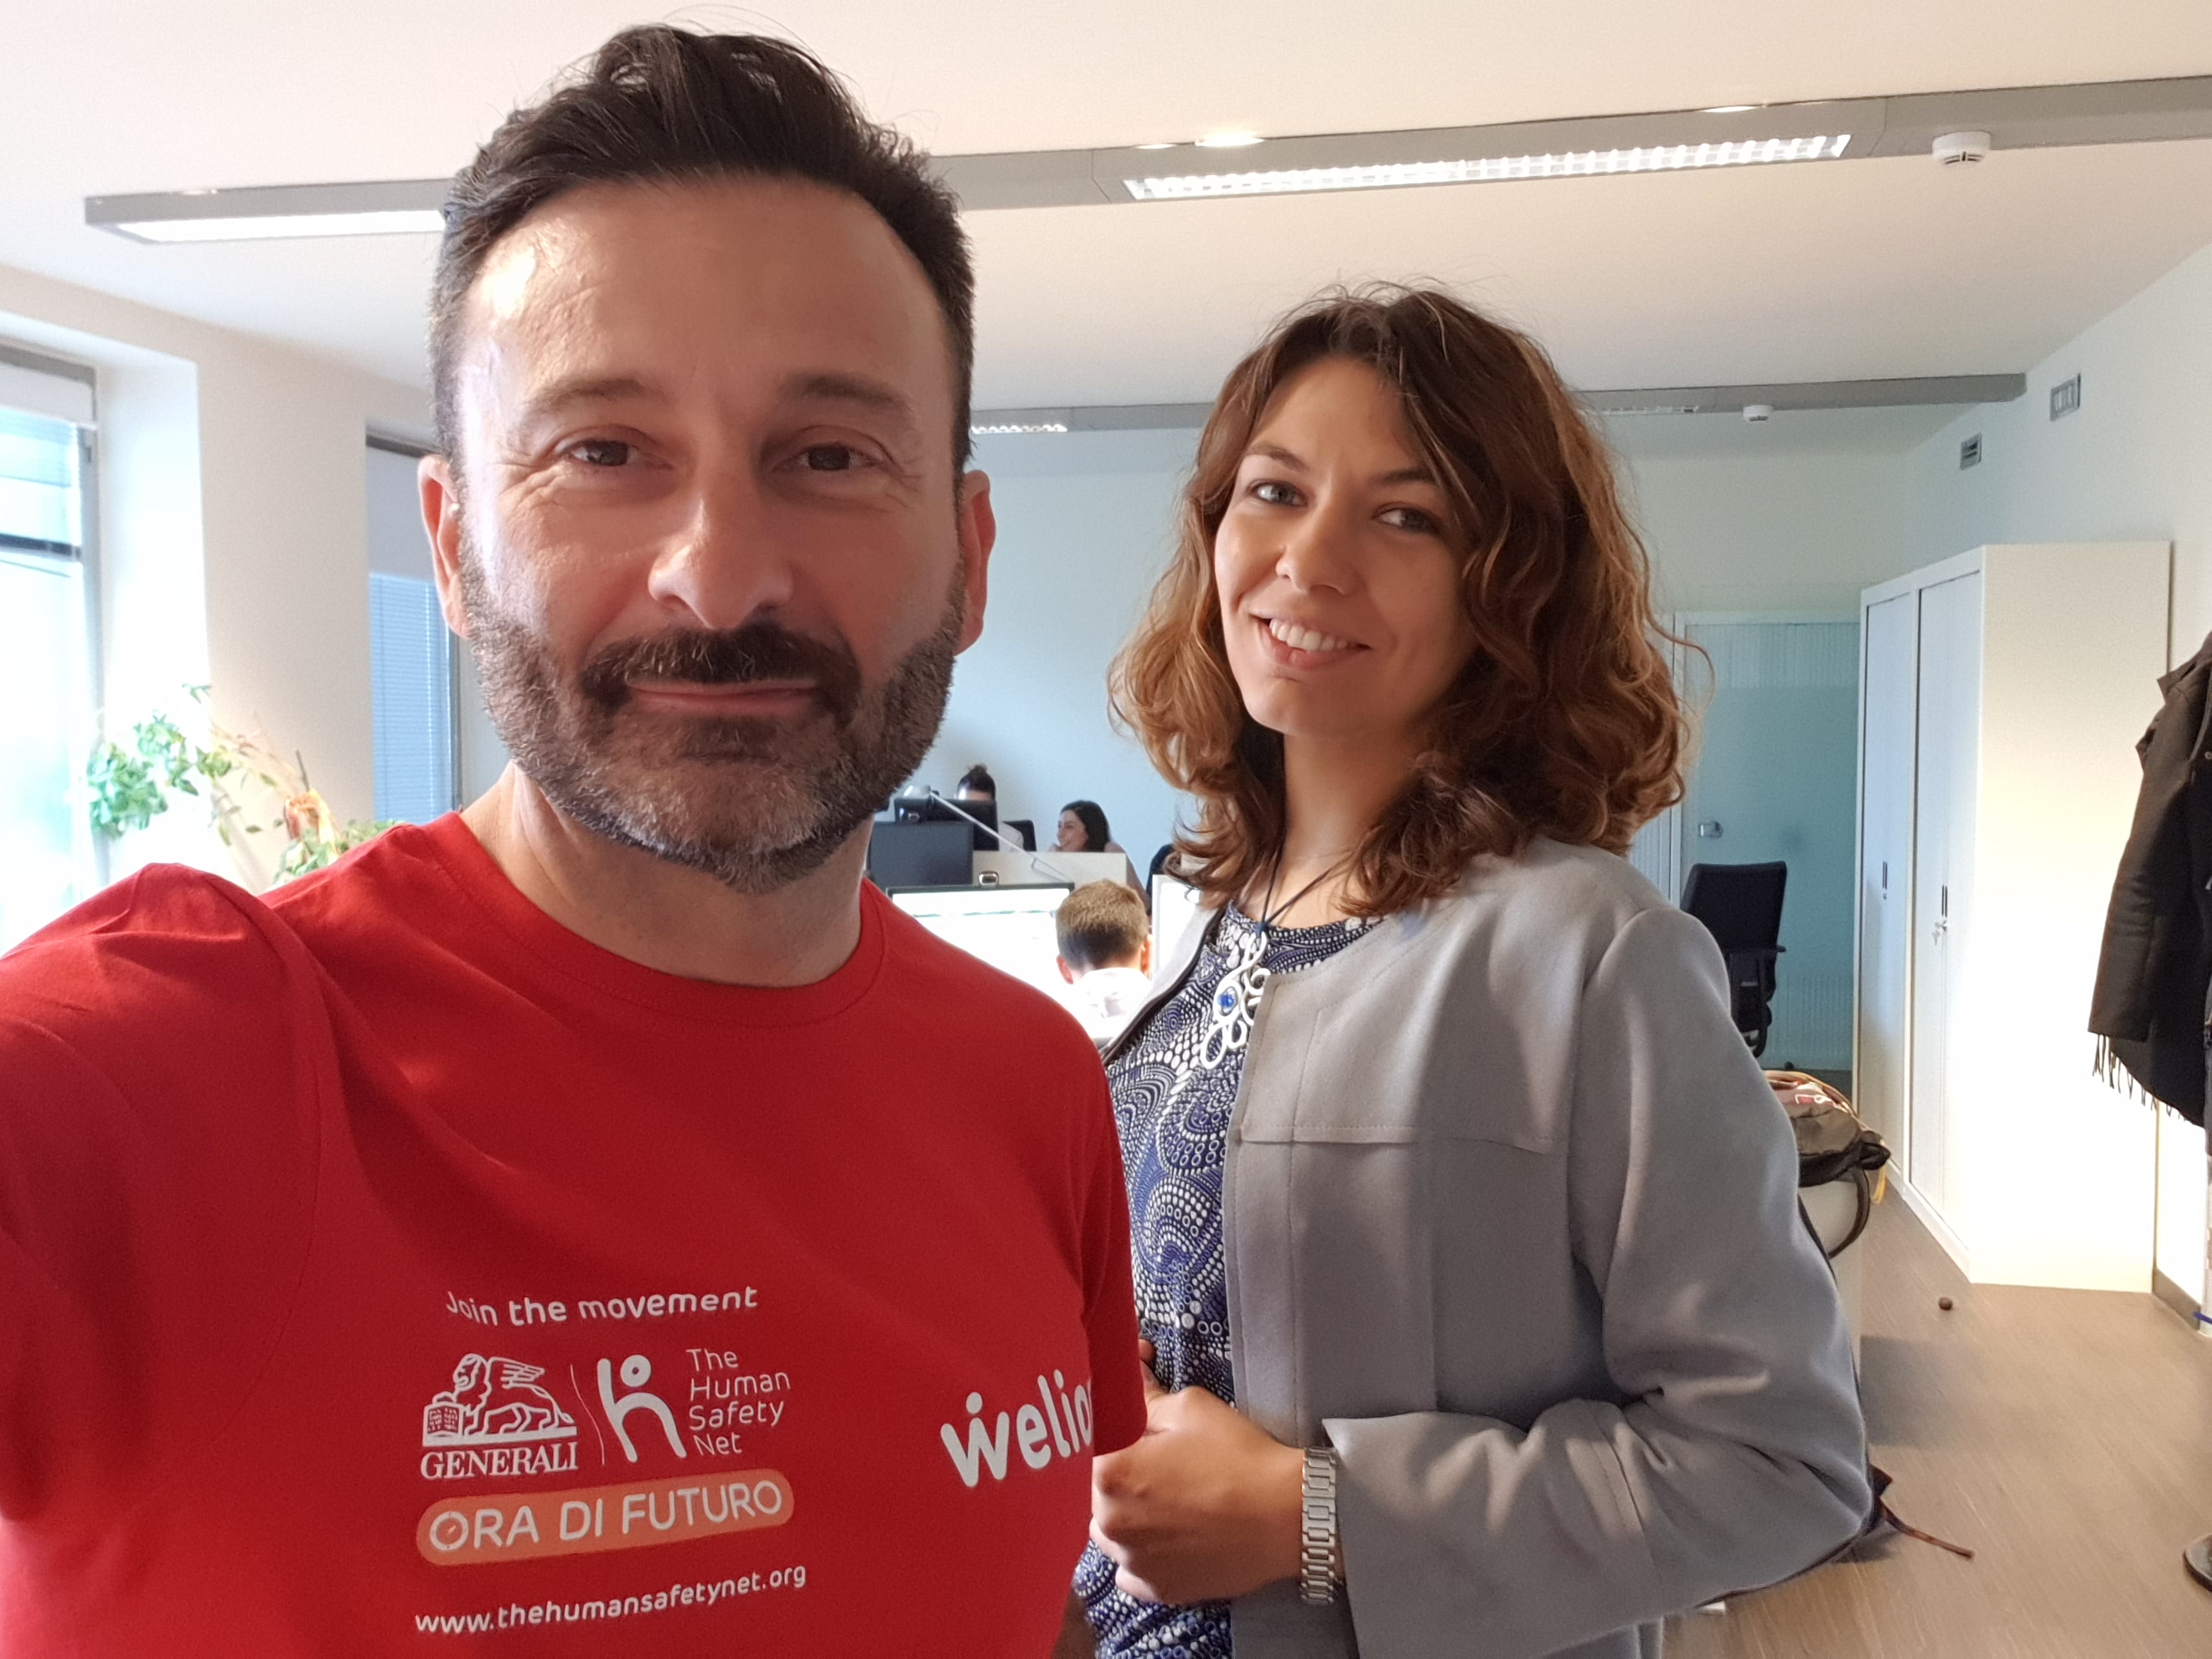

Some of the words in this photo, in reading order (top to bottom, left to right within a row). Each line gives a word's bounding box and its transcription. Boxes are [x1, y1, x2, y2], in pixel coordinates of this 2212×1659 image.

[447, 1291, 498, 1326] Join
[509, 1297, 567, 1326] the
[579, 1286, 757, 1319] movement
[686, 1348, 738, 1371] The
[690, 1371, 791, 1402] Human
[689, 1400, 785, 1431] Safety
[940, 1368, 1092, 1487] welio
[420, 1441, 579, 1480] GENERALI
[694, 1433, 742, 1456] Net
[429, 1506, 540, 1552] ORA
[559, 1499, 603, 1541] DI
[622, 1480, 783, 1535] FUTURO
[415, 1564, 807, 1634] www.thehumansafetynet.org
